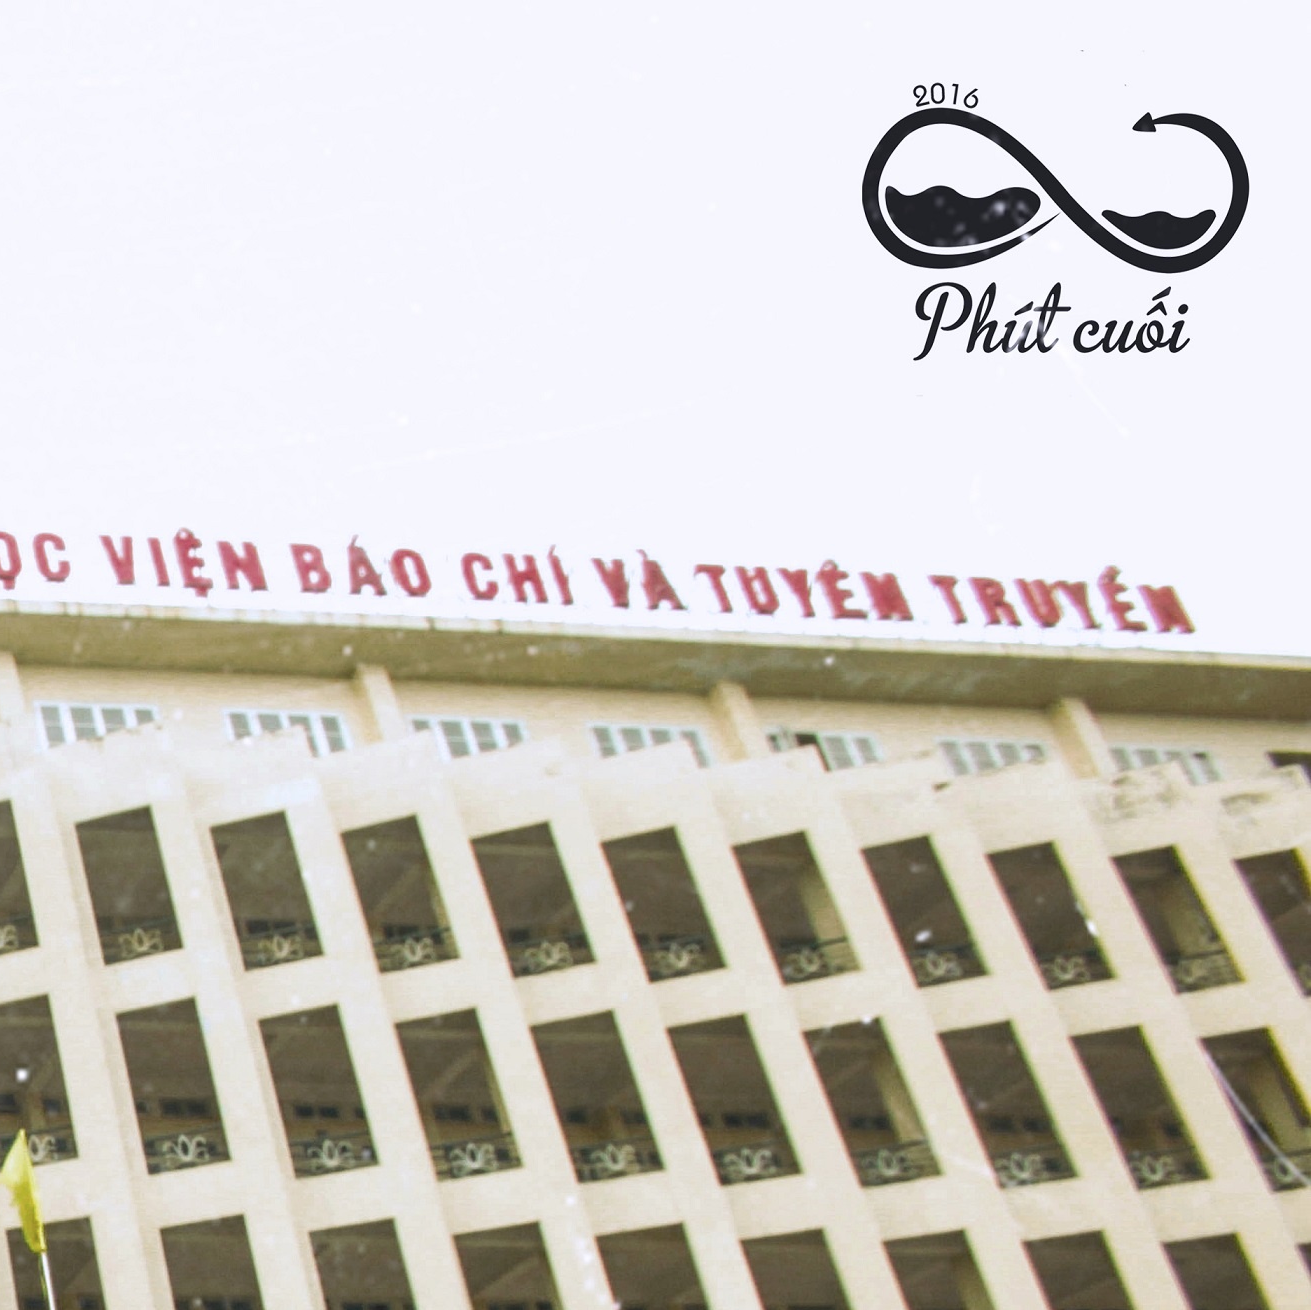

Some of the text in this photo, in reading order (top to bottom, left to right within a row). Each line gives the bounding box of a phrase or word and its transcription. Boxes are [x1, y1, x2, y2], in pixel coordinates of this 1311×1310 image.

[99, 527, 269, 598] VIỆN
[289, 534, 434, 598] BÁO
[460, 545, 574, 606] CHÍ
[590, 548, 688, 611] VÀ
[694, 559, 914, 622] TUYÊN
